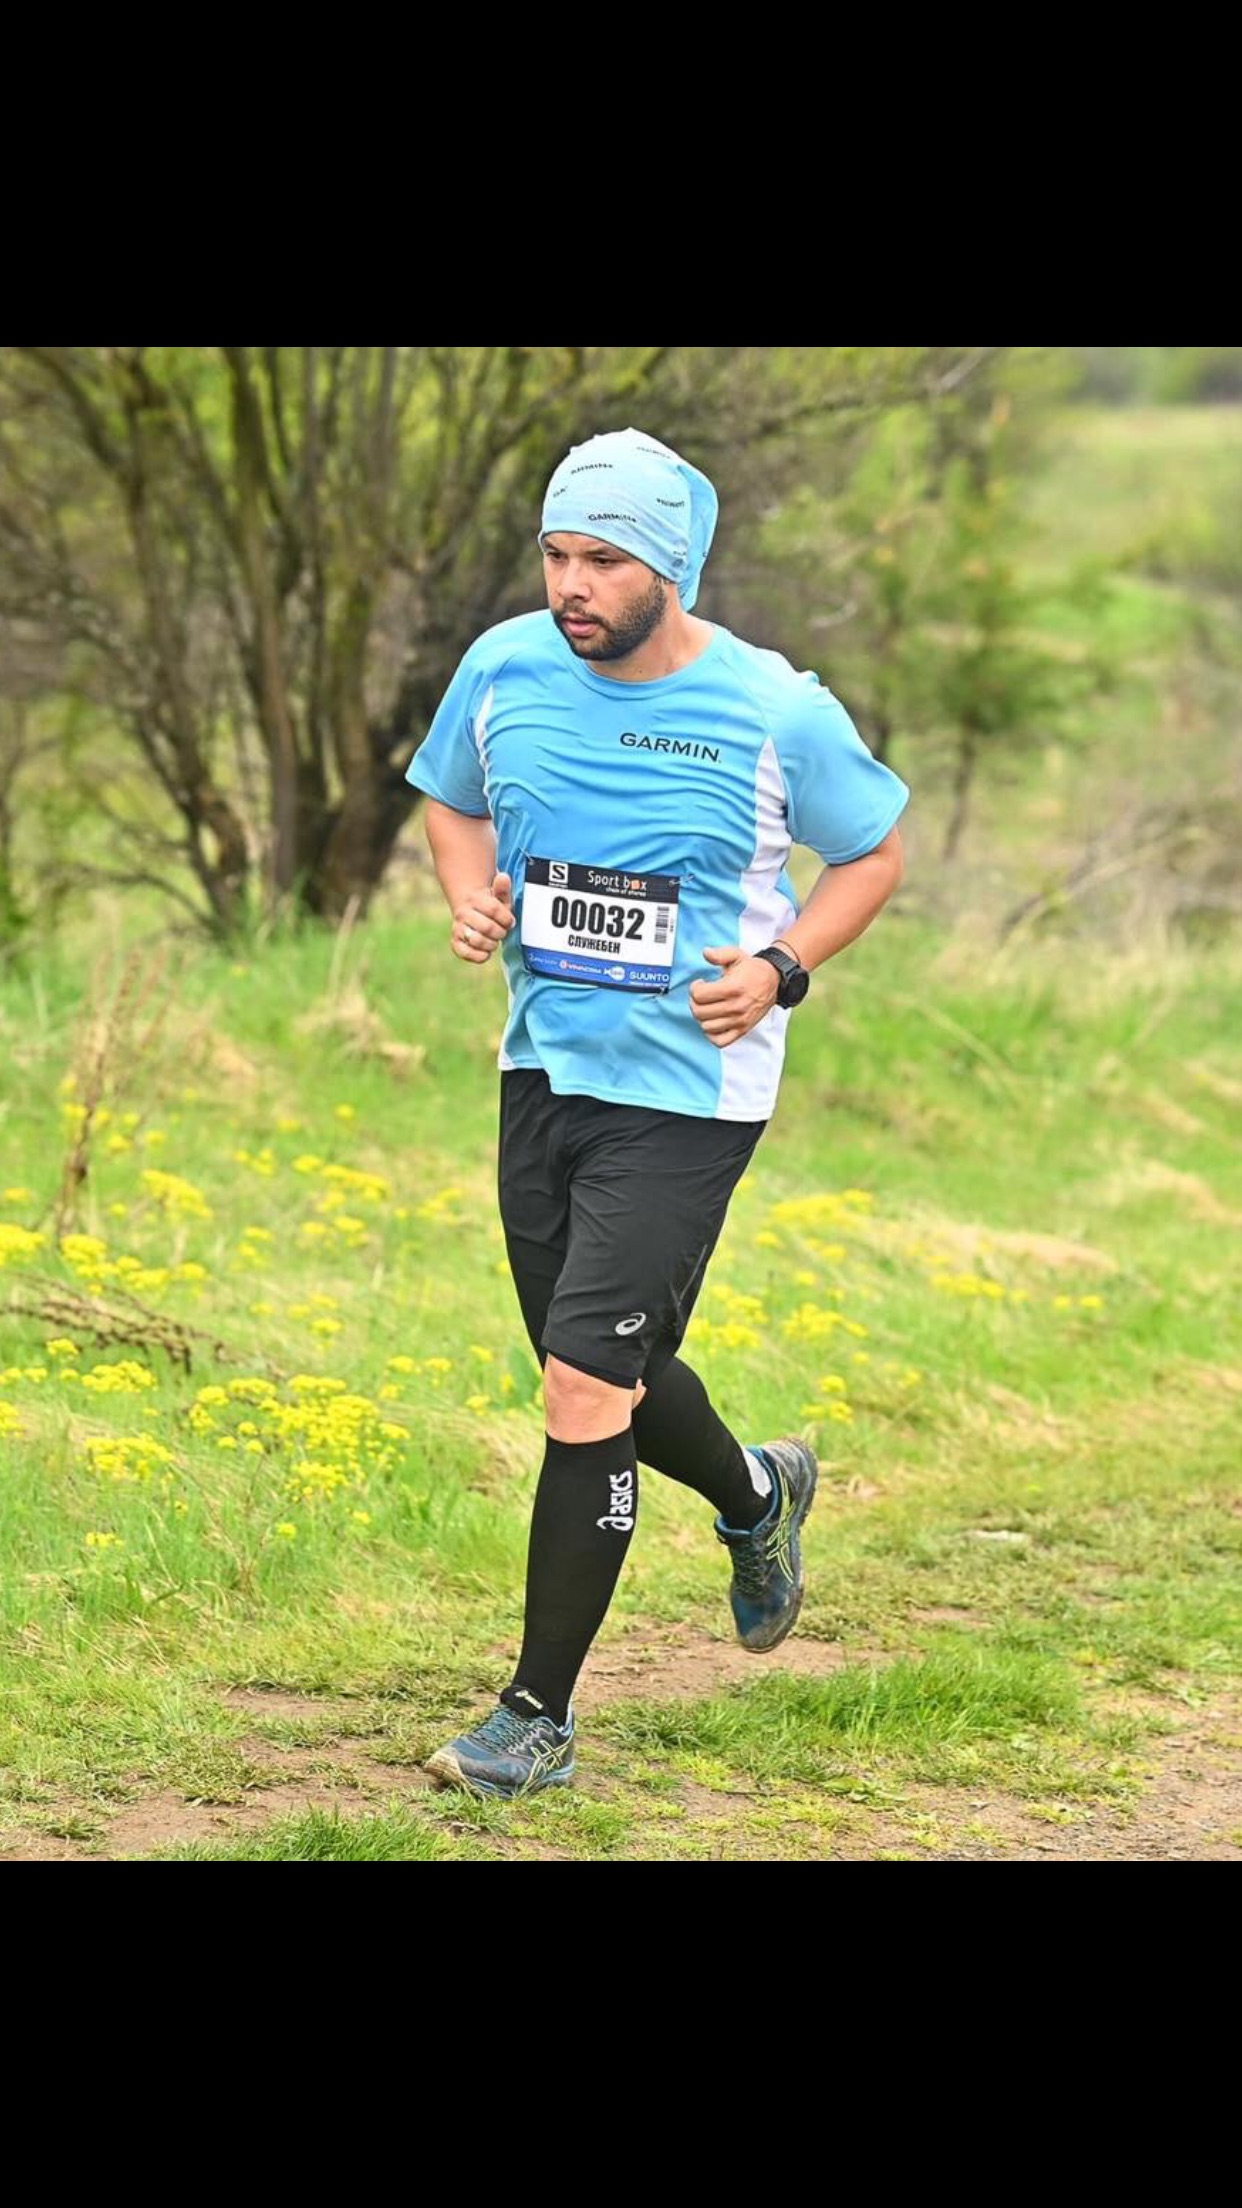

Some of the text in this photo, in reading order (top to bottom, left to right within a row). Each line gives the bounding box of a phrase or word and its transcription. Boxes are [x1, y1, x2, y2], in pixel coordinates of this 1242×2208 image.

[619, 732, 720, 763] GARMIN
[588, 870, 619, 887] Sport
[551, 896, 645, 940] 00032
[568, 934, 621, 954] СЛУЖЕБЕН
[629, 971, 670, 982] SUUNTO
[596, 1470, 634, 1531] asics
